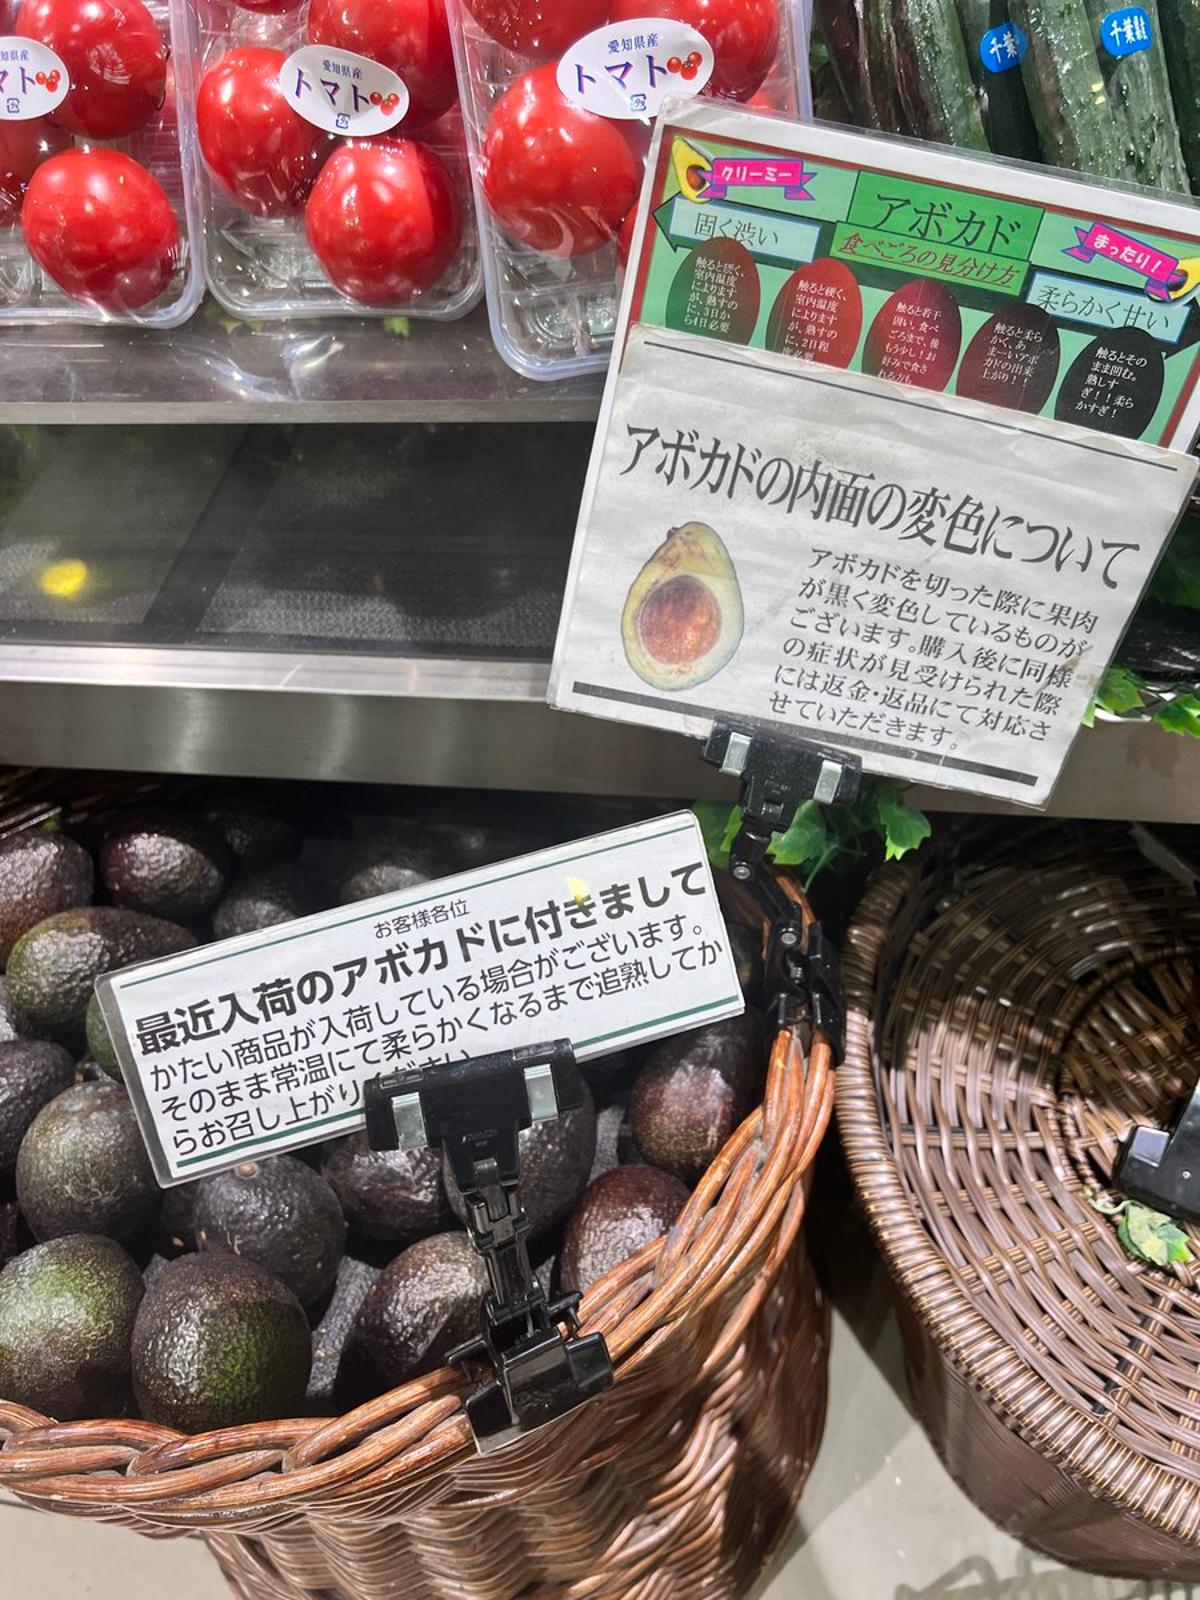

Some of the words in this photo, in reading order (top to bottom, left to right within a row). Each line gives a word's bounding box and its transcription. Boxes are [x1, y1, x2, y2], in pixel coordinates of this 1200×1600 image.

[323, 60, 364, 79] 愛知県産
[608, 33, 659, 54] 愛知県産
[295, 68, 370, 112] トマト
[574, 54, 668, 94] トマト
[721, 166, 793, 182] クリーミー
[694, 213, 780, 247] 固く渋い
[873, 194, 1021, 253] アボカド
[838, 232, 1020, 286] 食べごろの見分け方
[1093, 234, 1163, 273] まったり!
[691, 281, 737, 298] によります
[791, 307, 838, 326] によります
[1036, 285, 1169, 329] 柔らかく甘い
[1095, 346, 1148, 367] 触るとその
[619, 422, 1141, 590] アボカドの内面の変色について
[808, 547, 1098, 635] アボカドを切った際に果肉
[798, 577, 1087, 660] が黒く変色しているものが
[790, 606, 1073, 689] ございます。購入後に同様
[774, 664, 1051, 741] には返金・返品にて対応さ
[783, 636, 1062, 716] の症状が見受けられた際
[768, 691, 958, 751] せていただきます。
[374, 898, 471, 939] お客様各位
[134, 861, 707, 1056] 最近入荷のアボカドに付きまして
[150, 913, 703, 1091] かたい商品が入荷している場合がございます。
[160, 940, 723, 1121] そのまま常温にて柔らかくなるまで追熟してか
[172, 1049, 470, 1156] らお召し上がり
